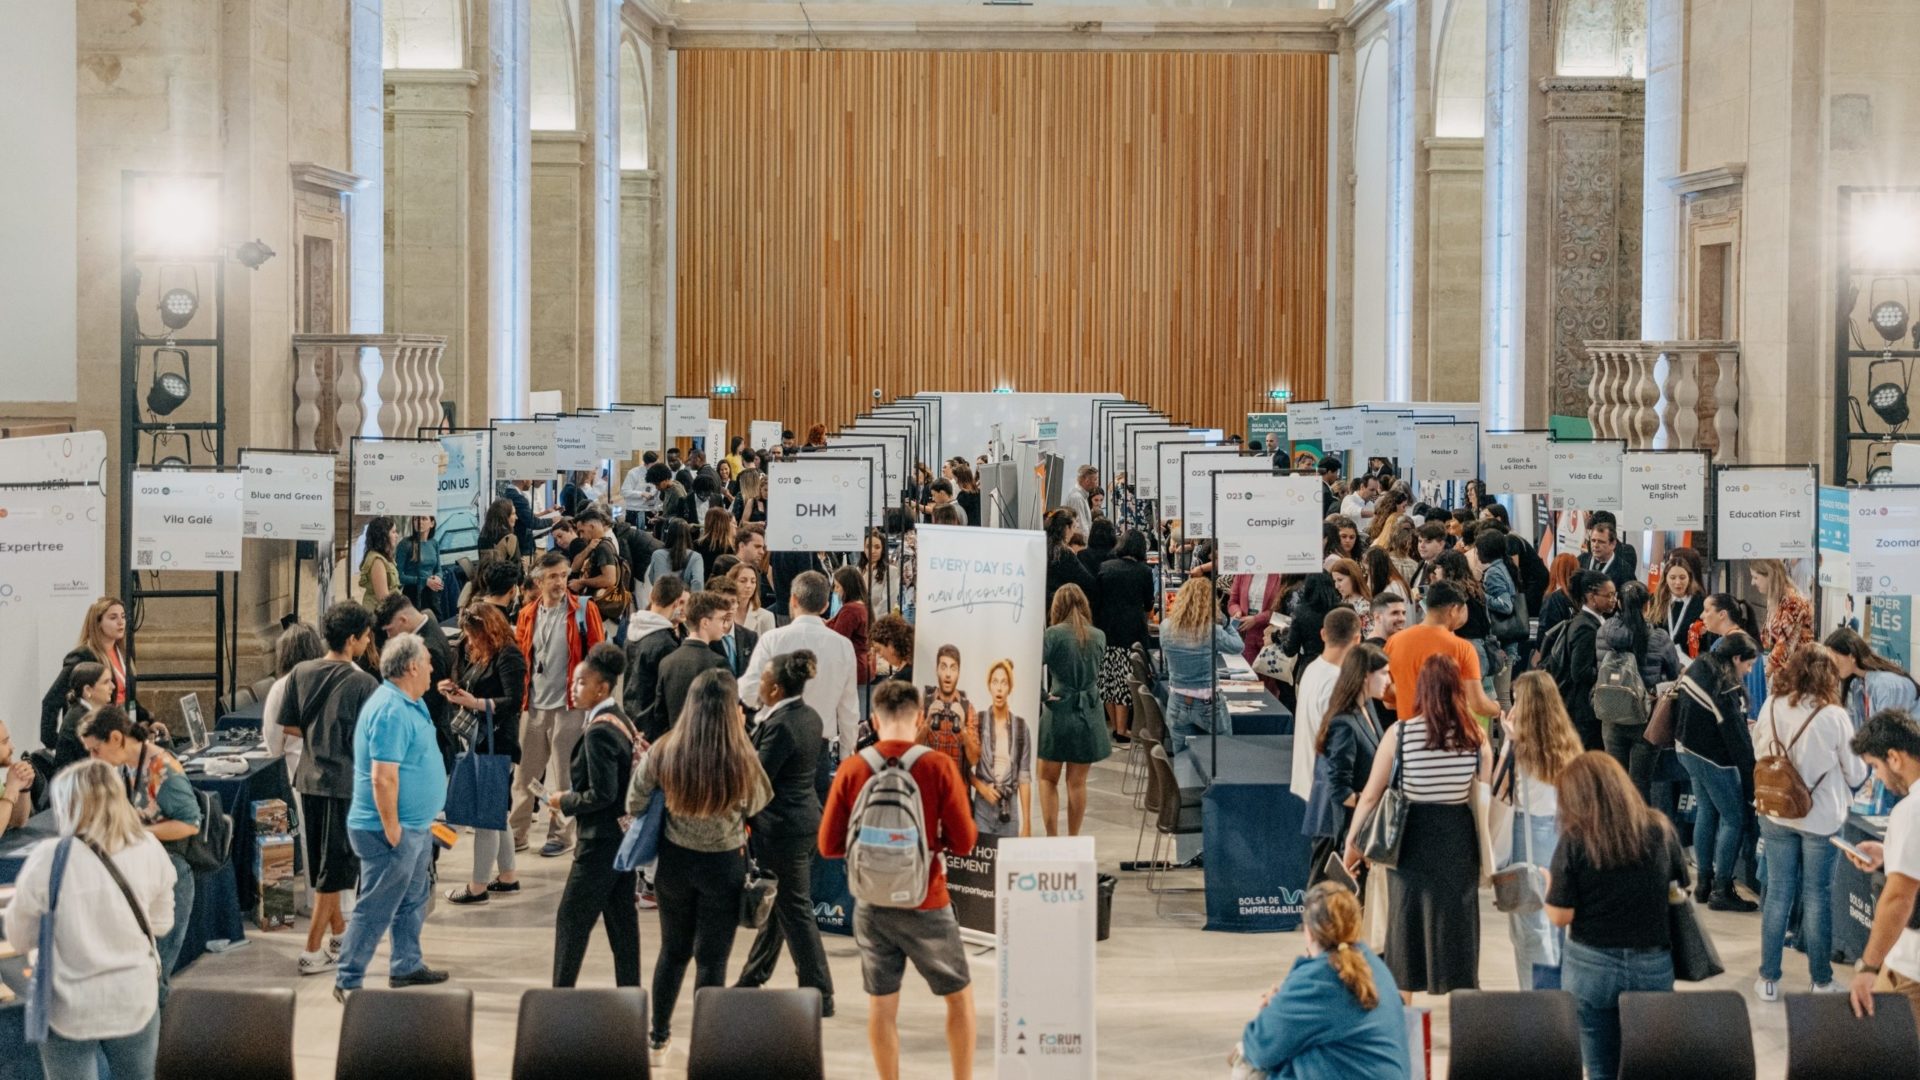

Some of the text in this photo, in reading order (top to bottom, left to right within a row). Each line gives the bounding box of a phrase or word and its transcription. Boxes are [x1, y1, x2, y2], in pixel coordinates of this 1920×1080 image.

[517, 444, 548, 452] Lourenço
[1569, 472, 1603, 480] Vida Edu
[437, 478, 470, 491] JOIN US
[1641, 483, 1687, 491] Wall Street
[141, 487, 160, 495] 020
[250, 491, 323, 501] Blue and Green
[1226, 492, 1243, 500] 023
[1649, 492, 1679, 500] English
[795, 503, 837, 517] DHM
[1729, 509, 1801, 519] Education First
[1858, 508, 1877, 516] 024
[163, 514, 213, 525] Vila Galé
[1246, 517, 1295, 528] Campigir
[0, 541, 64, 554] Expertree
[1875, 538, 1920, 548] Zoomar
[929, 556, 1026, 577] EVERY DAY IS A
[928, 573, 1024, 624] new discovery
[1040, 888, 1085, 904] talks
[1239, 896, 1280, 905] BOLSA DE
[1849, 892, 1872, 915] BOLSA DE
[1239, 905, 1305, 915] EMPREGABILID
[1001, 897, 1009, 1055] CONHEÇA O PROGRAMA COMPLETO
[1040, 1046, 1082, 1055] TURISMO
